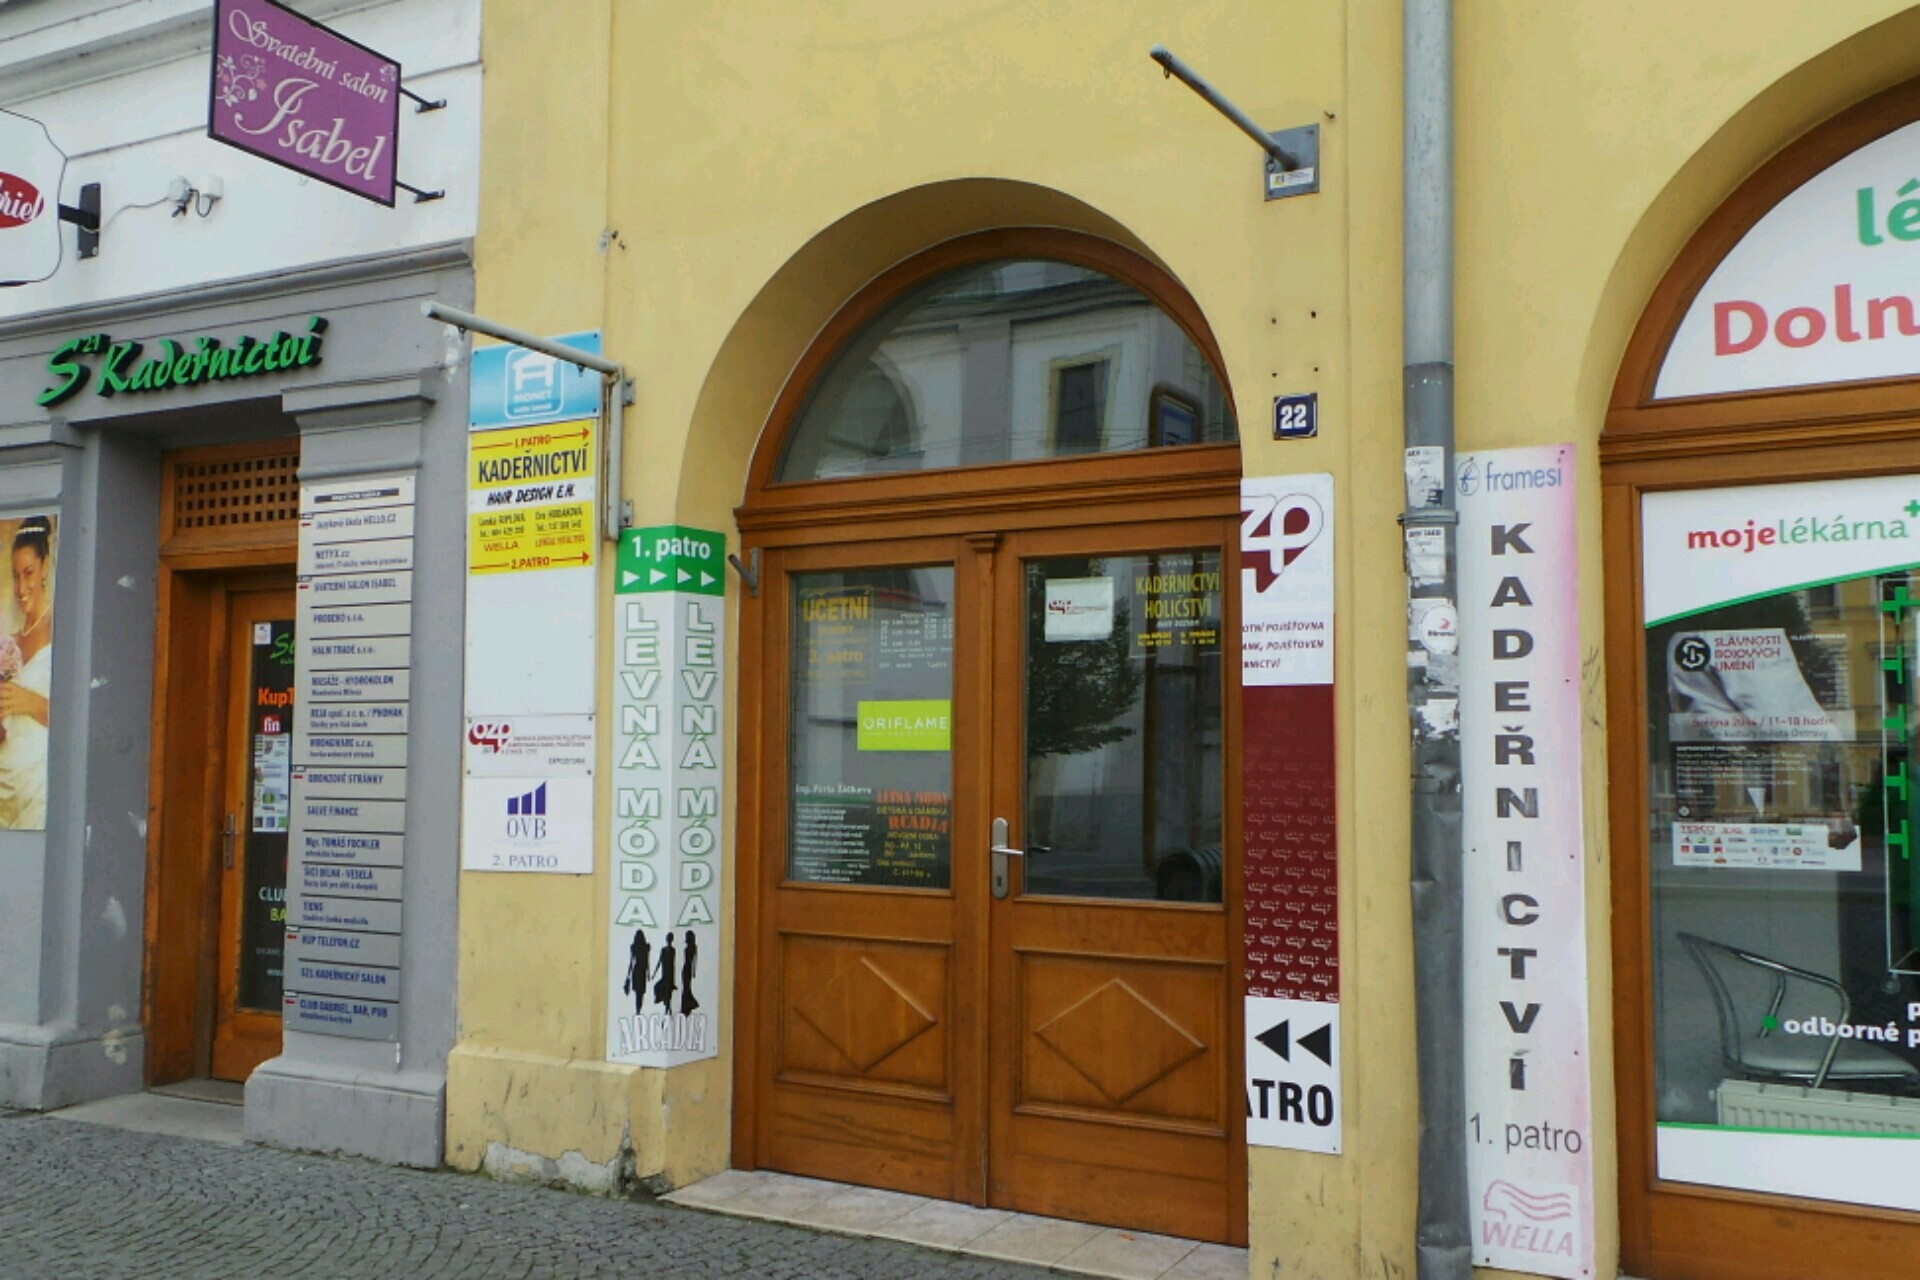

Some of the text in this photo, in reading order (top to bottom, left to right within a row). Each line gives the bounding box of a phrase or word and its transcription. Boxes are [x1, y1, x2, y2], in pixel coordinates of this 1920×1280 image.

[338, 69, 388, 103] salon
[0, 178, 44, 223] riel
[1857, 177, 1920, 247] lé
[1714, 283, 1920, 357] Doln
[1280, 404, 1306, 429] 22
[479, 442, 589, 483] KADEŘNICTVÍ
[1486, 458, 1563, 492] framesi
[488, 489, 512, 506] HAIR
[516, 485, 554, 503] DESIGN
[484, 541, 519, 552] WELLA
[631, 536, 712, 562] 1. patro
[1135, 567, 1220, 595] KADEŘNICTVÍ
[1144, 592, 1212, 619] HOLIČSTVÍ
[1714, 635, 1781, 647] SLAVNOSTI
[863, 716, 948, 730] ORIFLAME
[615, 602, 661, 929] LEVNÁ MÓDA
[676, 602, 718, 927] LEVNÁ MÓDA
[1489, 520, 1540, 1092] KADEŘNICTVÍ
[506, 817, 547, 841] OVB
[508, 854, 559, 869] PATRO
[1783, 1016, 1900, 1042] odborné
[1470, 1113, 1583, 1155] 1. patro
[1483, 1220, 1574, 1258] WELLA
